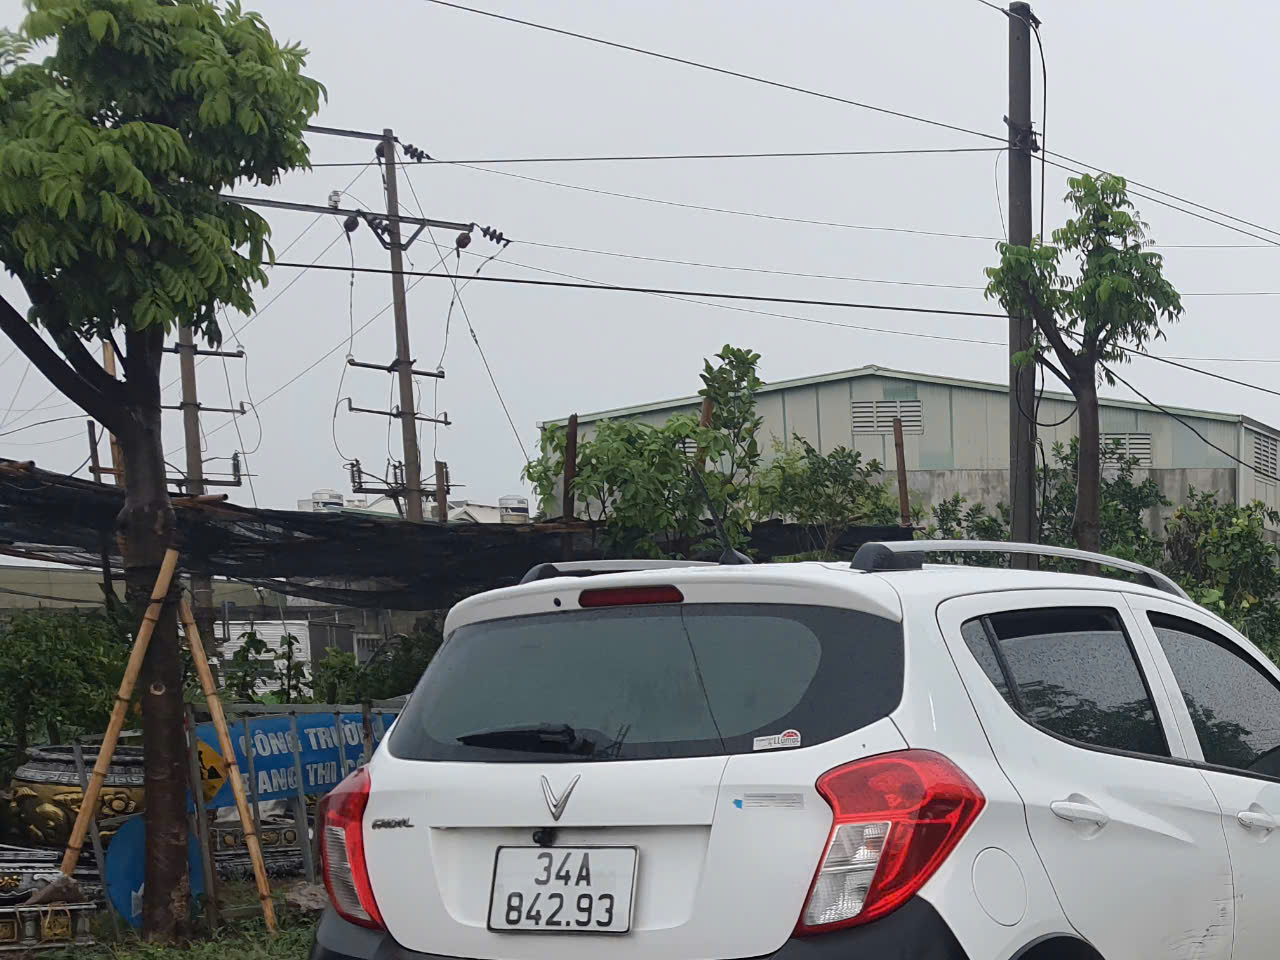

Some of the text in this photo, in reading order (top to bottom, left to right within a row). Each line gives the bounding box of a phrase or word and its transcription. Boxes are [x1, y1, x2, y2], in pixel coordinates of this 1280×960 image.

[305, 761, 337, 786] THI
[534, 851, 592, 887] 34A
[505, 891, 615, 927] 842.93
